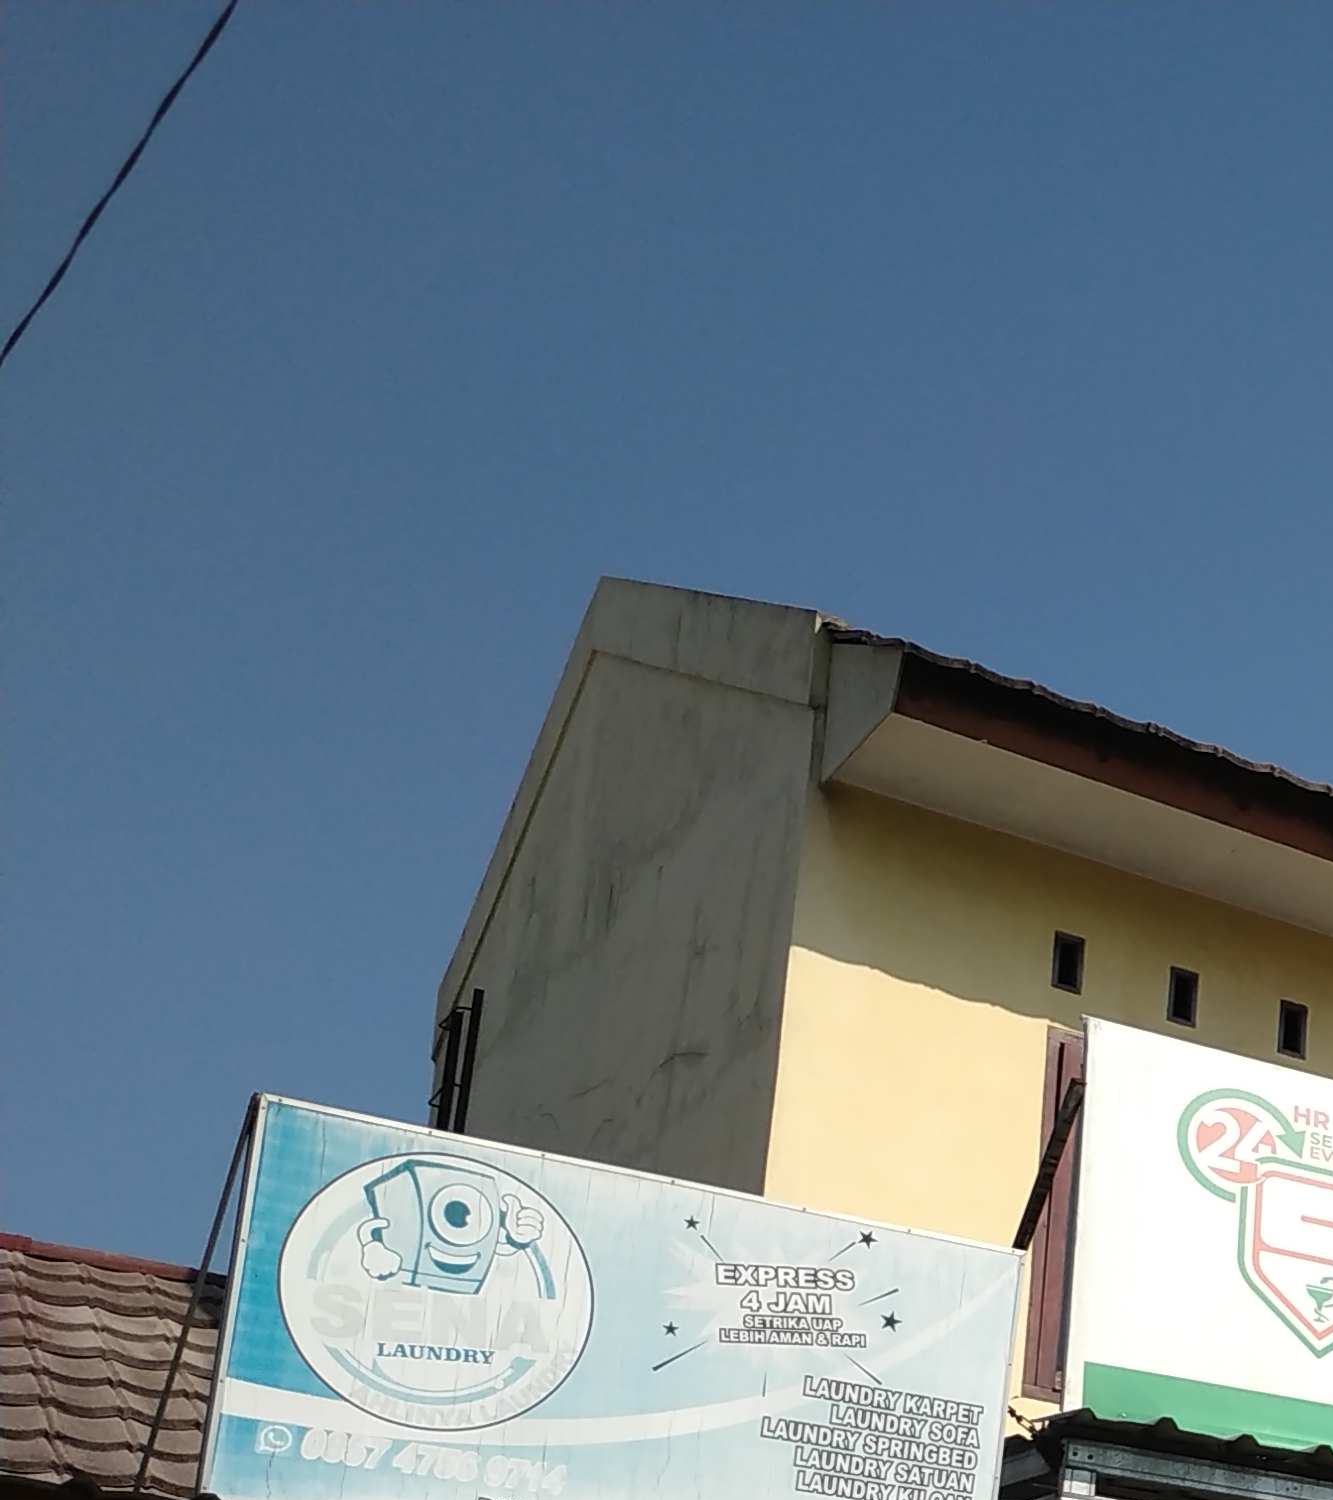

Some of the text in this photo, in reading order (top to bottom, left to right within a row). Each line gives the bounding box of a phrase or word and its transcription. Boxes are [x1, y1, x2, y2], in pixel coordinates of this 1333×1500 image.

[1293, 1105, 1330, 1130] HR
[715, 1262, 855, 1291] EXPRESS
[310, 1284, 549, 1354] SENA
[740, 1289, 832, 1315] 4 JAM
[719, 1327, 867, 1348] LEBIH AMAN & RAPI
[743, 1314, 844, 1332] SETRIKA UAP
[376, 1341, 496, 1365] LAUNDRY
[803, 1374, 984, 1426] LAUNDRY KARPET
[760, 1416, 978, 1471] LAUNDRY SPRINGBED
[829, 1404, 981, 1449] LAUNDRY SOFA
[300, 1426, 568, 1496] 0857 4756 9714
[793, 1445, 975, 1494] LAUNDRY SATUAN
